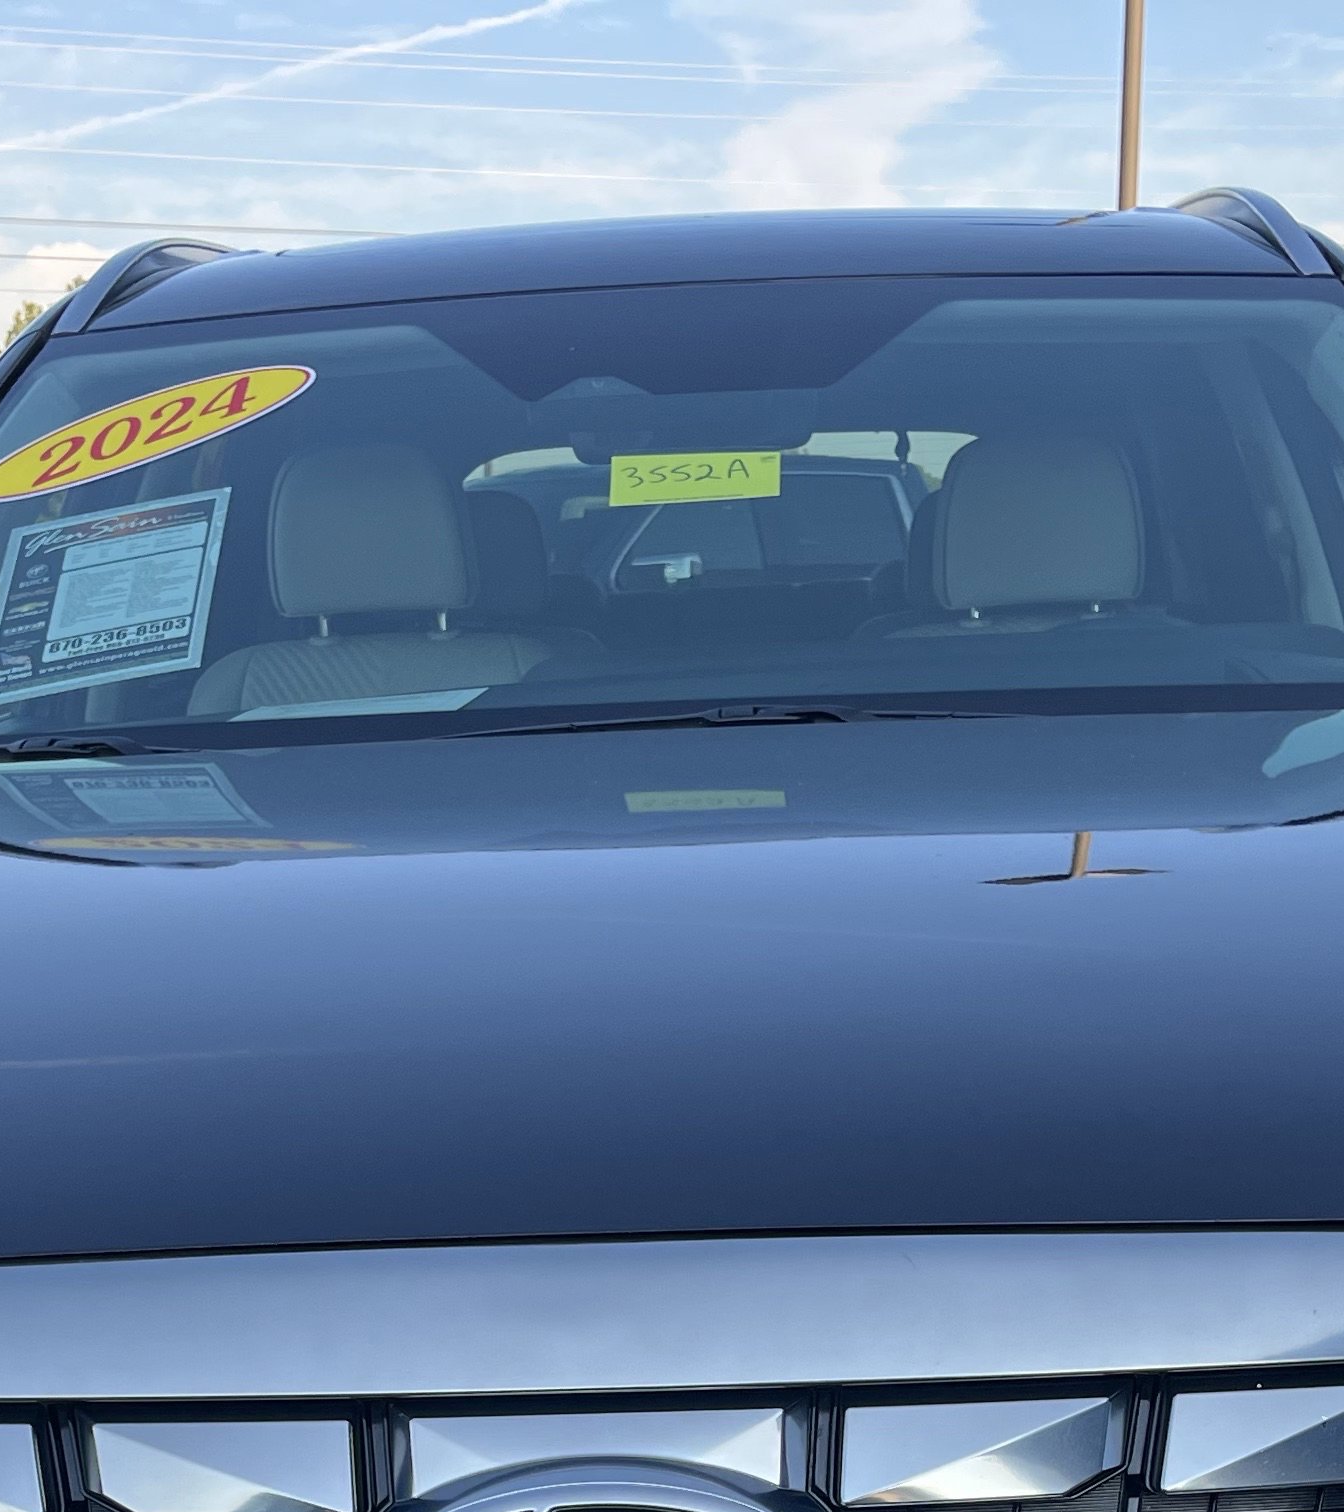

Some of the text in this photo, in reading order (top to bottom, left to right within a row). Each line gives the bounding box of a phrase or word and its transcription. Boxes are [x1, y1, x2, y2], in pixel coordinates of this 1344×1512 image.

[32, 375, 256, 487] 2024
[620, 458, 749, 488] 3552A
[25, 528, 89, 557] Glen
[88, 517, 162, 538] Sain
